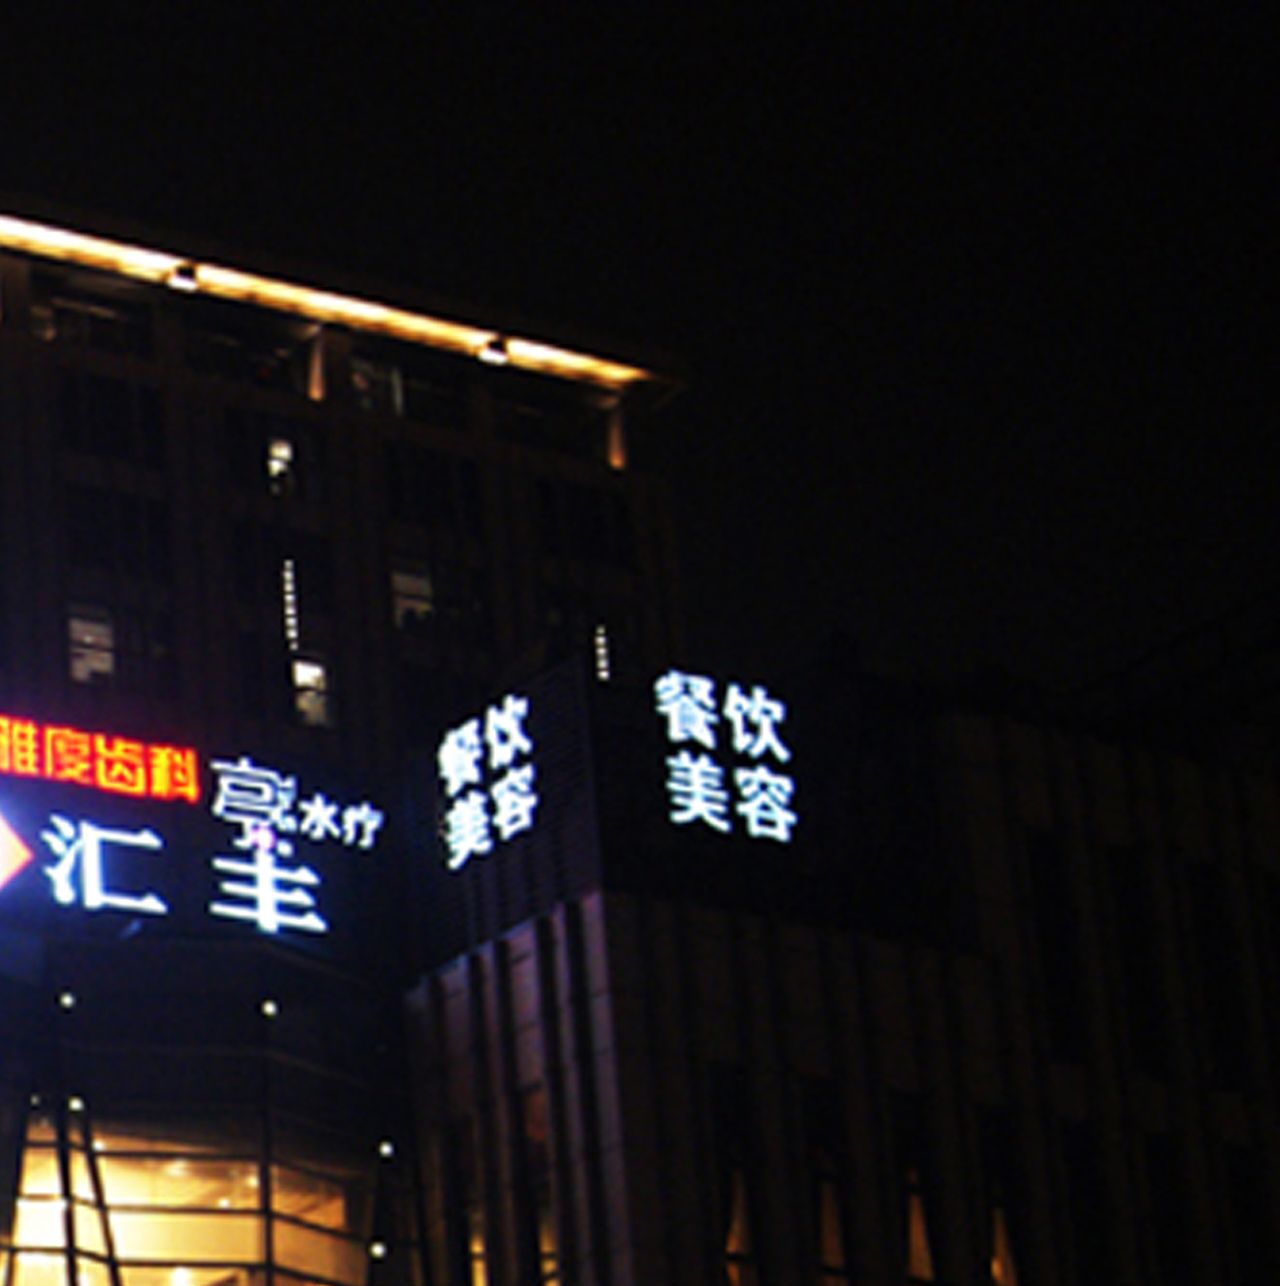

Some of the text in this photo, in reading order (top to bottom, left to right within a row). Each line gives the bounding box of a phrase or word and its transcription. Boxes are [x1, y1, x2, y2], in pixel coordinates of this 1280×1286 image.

[654, 668, 792, 763] 餐饮
[444, 763, 538, 871] 美容
[665, 750, 798, 844] 美容
[42, 814, 328, 933] 汇丰
